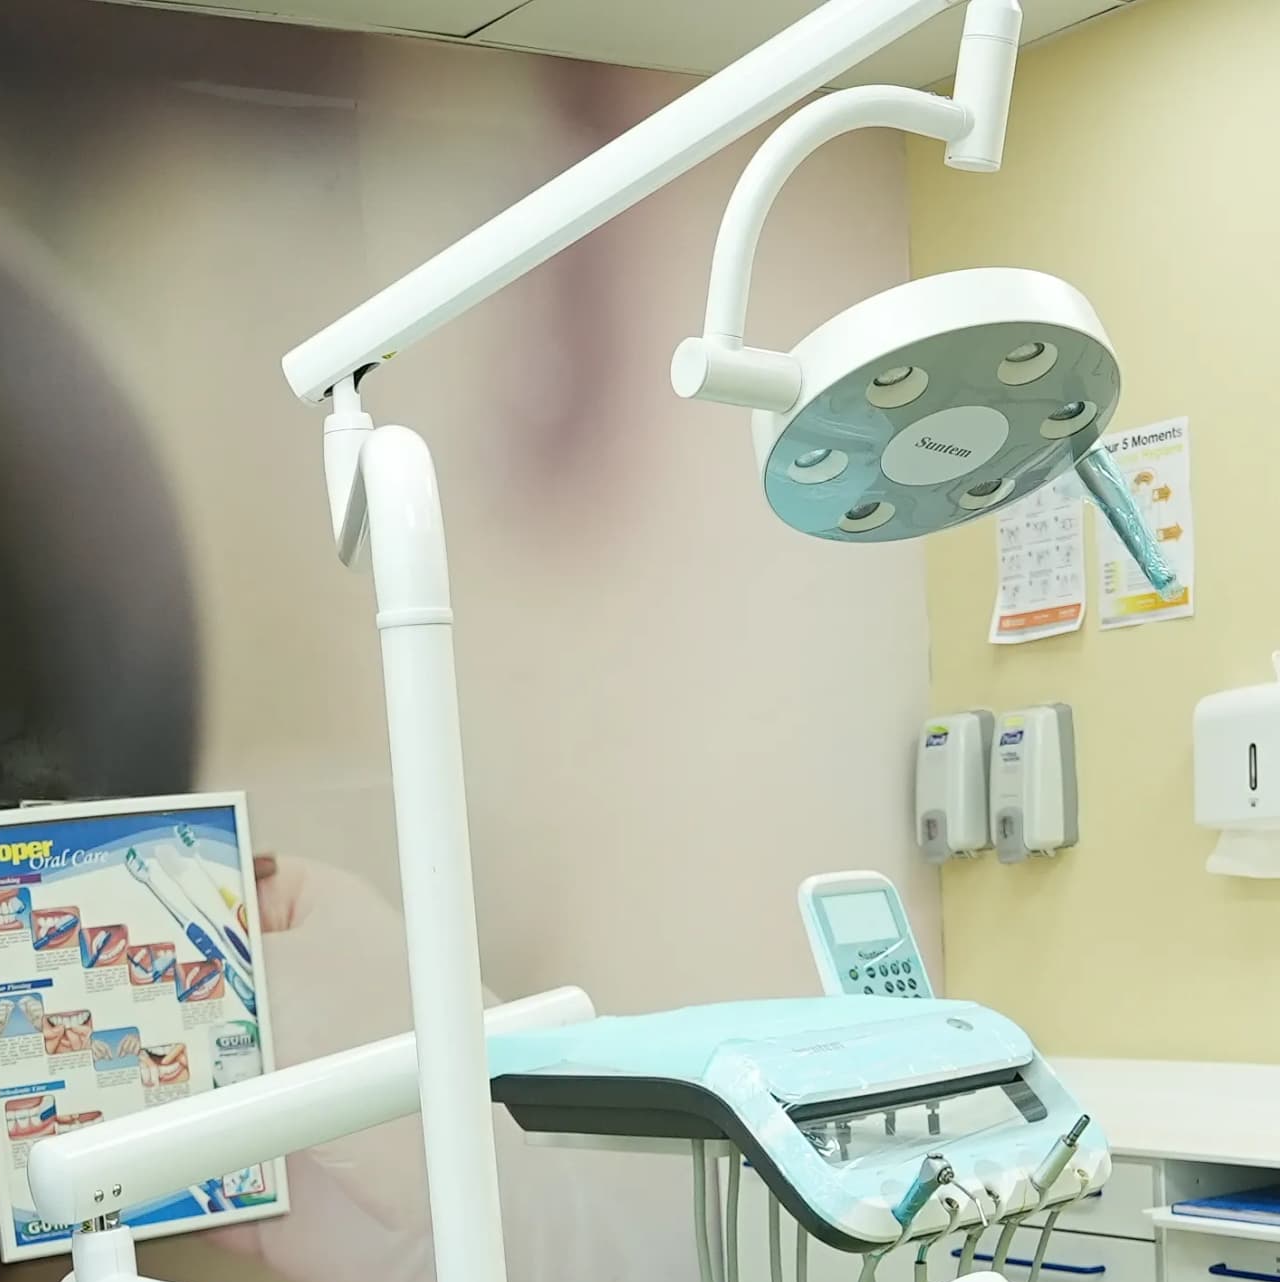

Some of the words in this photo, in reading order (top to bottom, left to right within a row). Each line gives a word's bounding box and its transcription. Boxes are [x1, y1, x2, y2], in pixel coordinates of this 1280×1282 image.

[915, 436, 972, 459] Suntem
[1122, 437, 1128, 449] 5
[1132, 427, 1182, 448] Moments
[29, 849, 69, 870] Oral
[72, 850, 109, 866] Care
